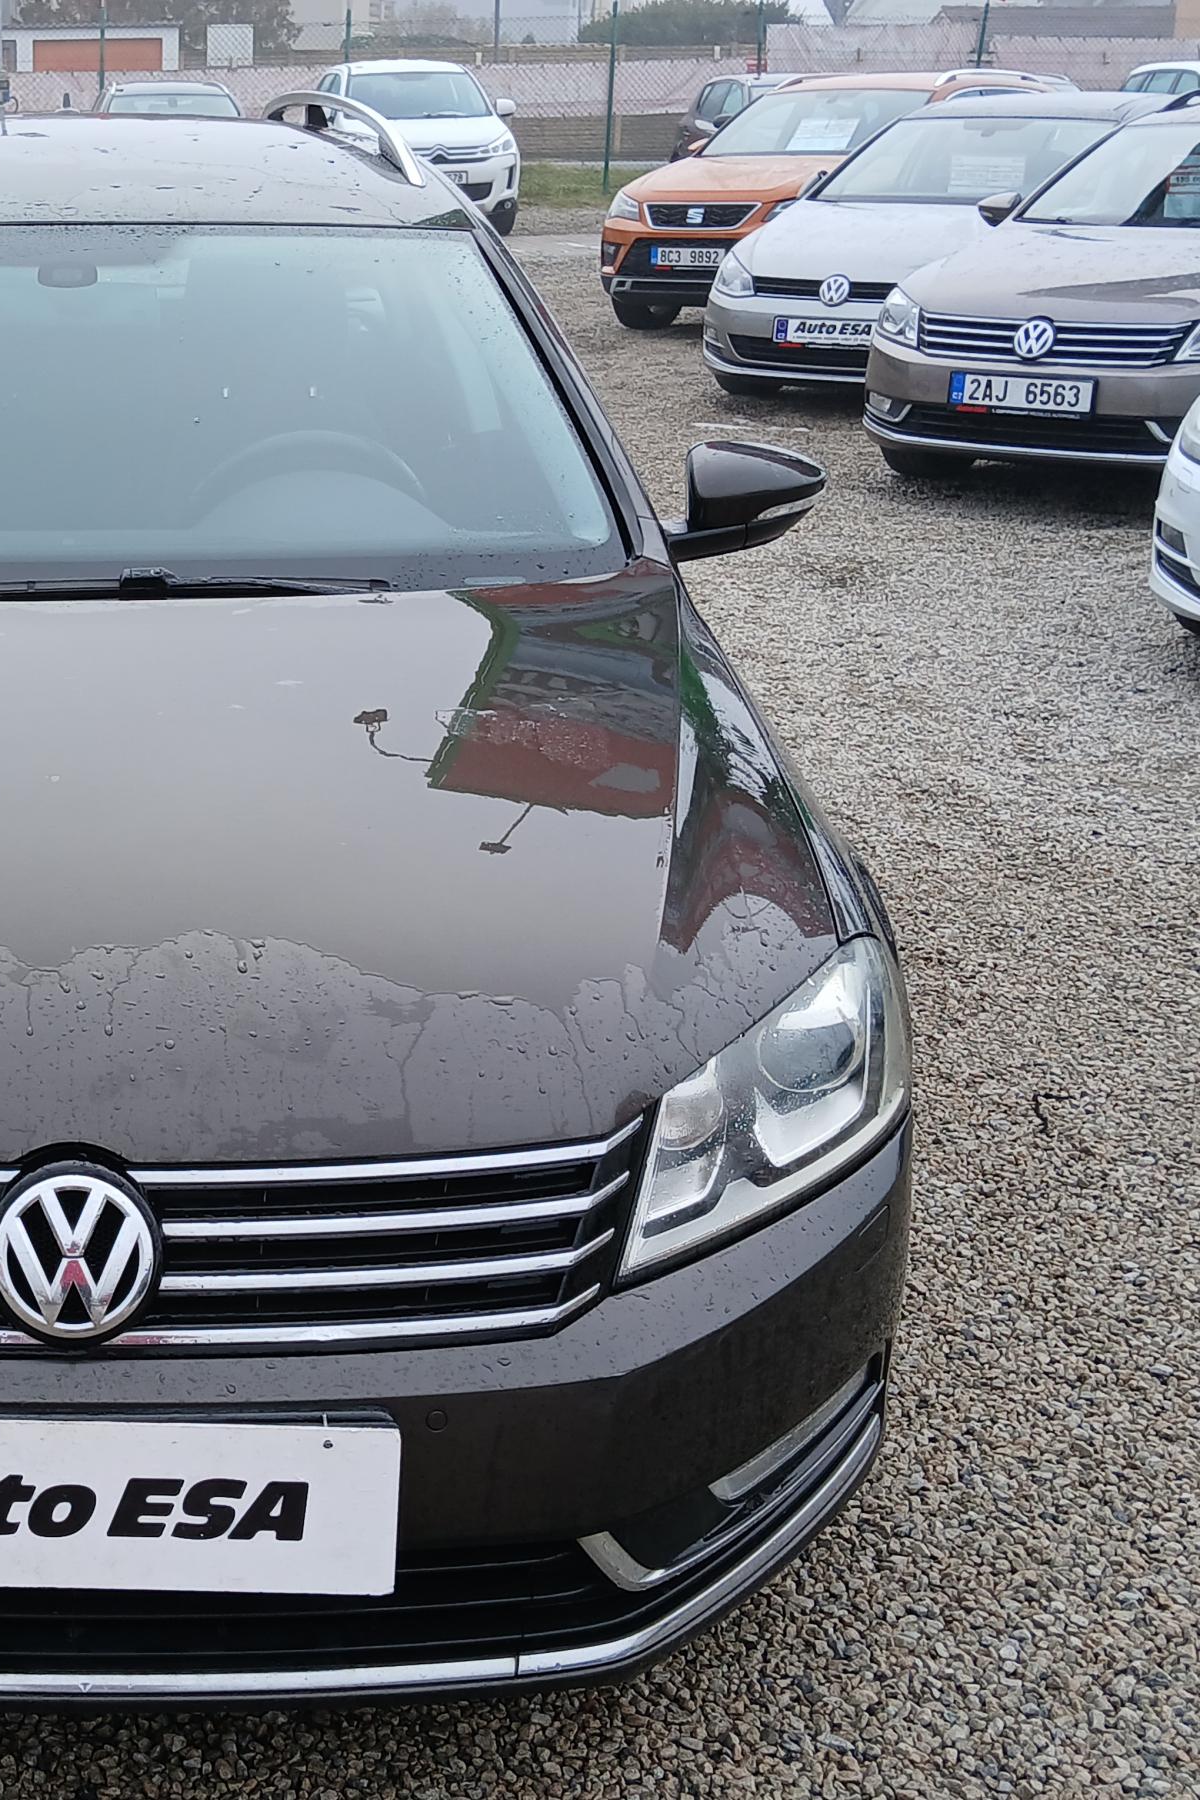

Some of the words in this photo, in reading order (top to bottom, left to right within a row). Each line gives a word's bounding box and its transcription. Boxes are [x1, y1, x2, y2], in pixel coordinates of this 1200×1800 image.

[660, 250, 681, 263] 8C3
[690, 251, 719, 264] 9892
[794, 321, 836, 335] Auto
[838, 323, 872, 336] ESA
[968, 378, 1009, 402] 2AJ
[1025, 382, 1081, 407] 6563
[106, 1478, 309, 1542] ESA
